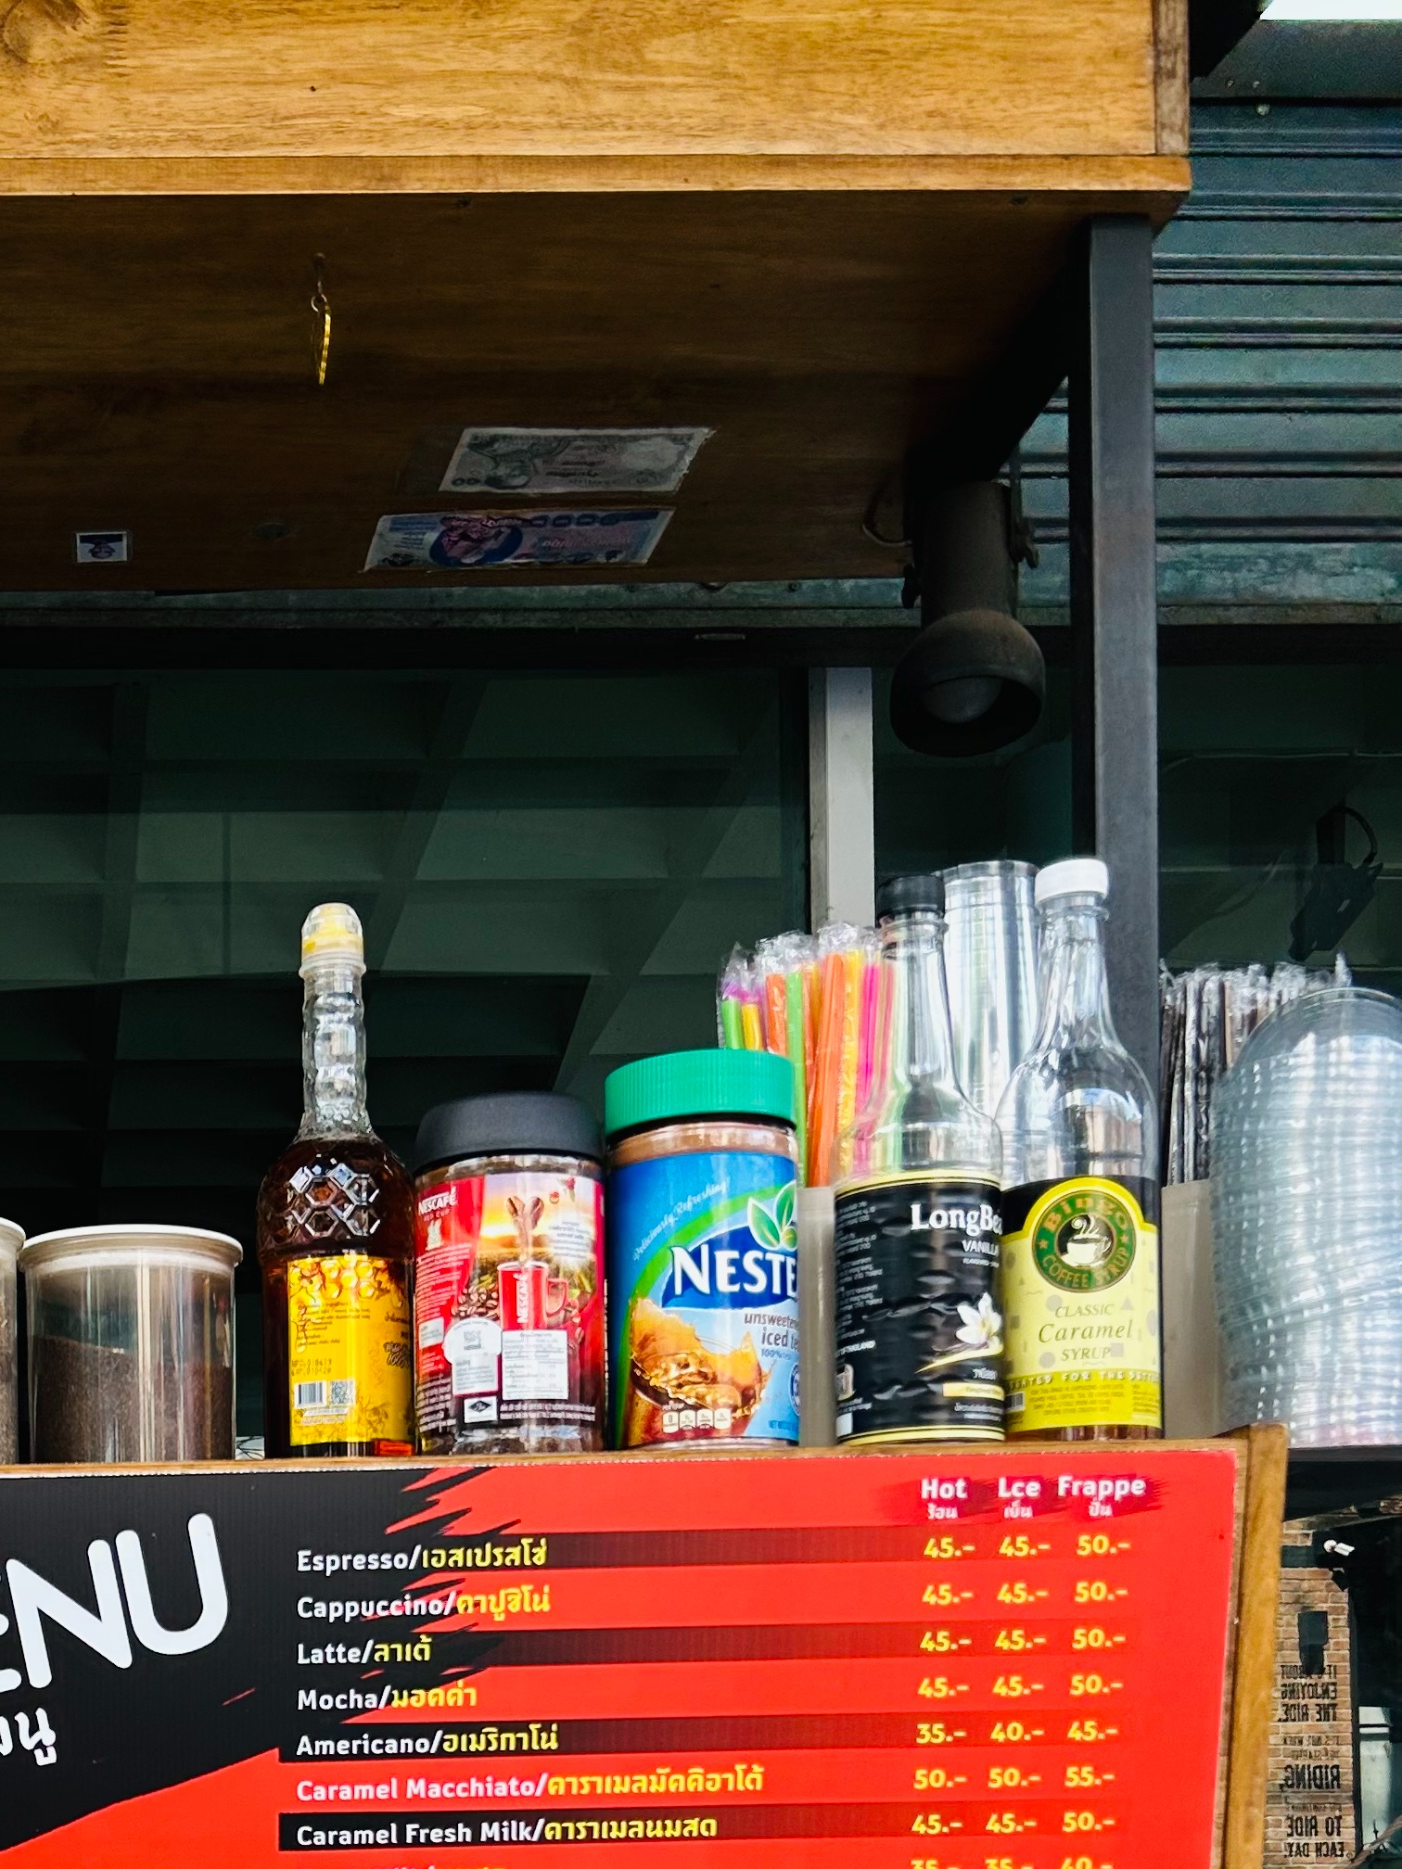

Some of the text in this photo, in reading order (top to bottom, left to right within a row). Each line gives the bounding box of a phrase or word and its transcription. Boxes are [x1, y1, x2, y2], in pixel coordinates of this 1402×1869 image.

[910, 1203, 1003, 1237] LongBe
[671, 1243, 798, 1299] NESTE
[1043, 1255, 1089, 1288] COFFEE
[1055, 1303, 1115, 1319] CLASSIC
[761, 1327, 788, 1347] iced
[1038, 1319, 1133, 1344] Caramel
[1061, 1346, 1111, 1362] SYRUP
[920, 1475, 1147, 1501] Hot Lce Frappe
[296, 1777, 398, 1801] Caramel
[297, 1822, 398, 1846] Caramel
[405, 1822, 472, 1844] Fresh
